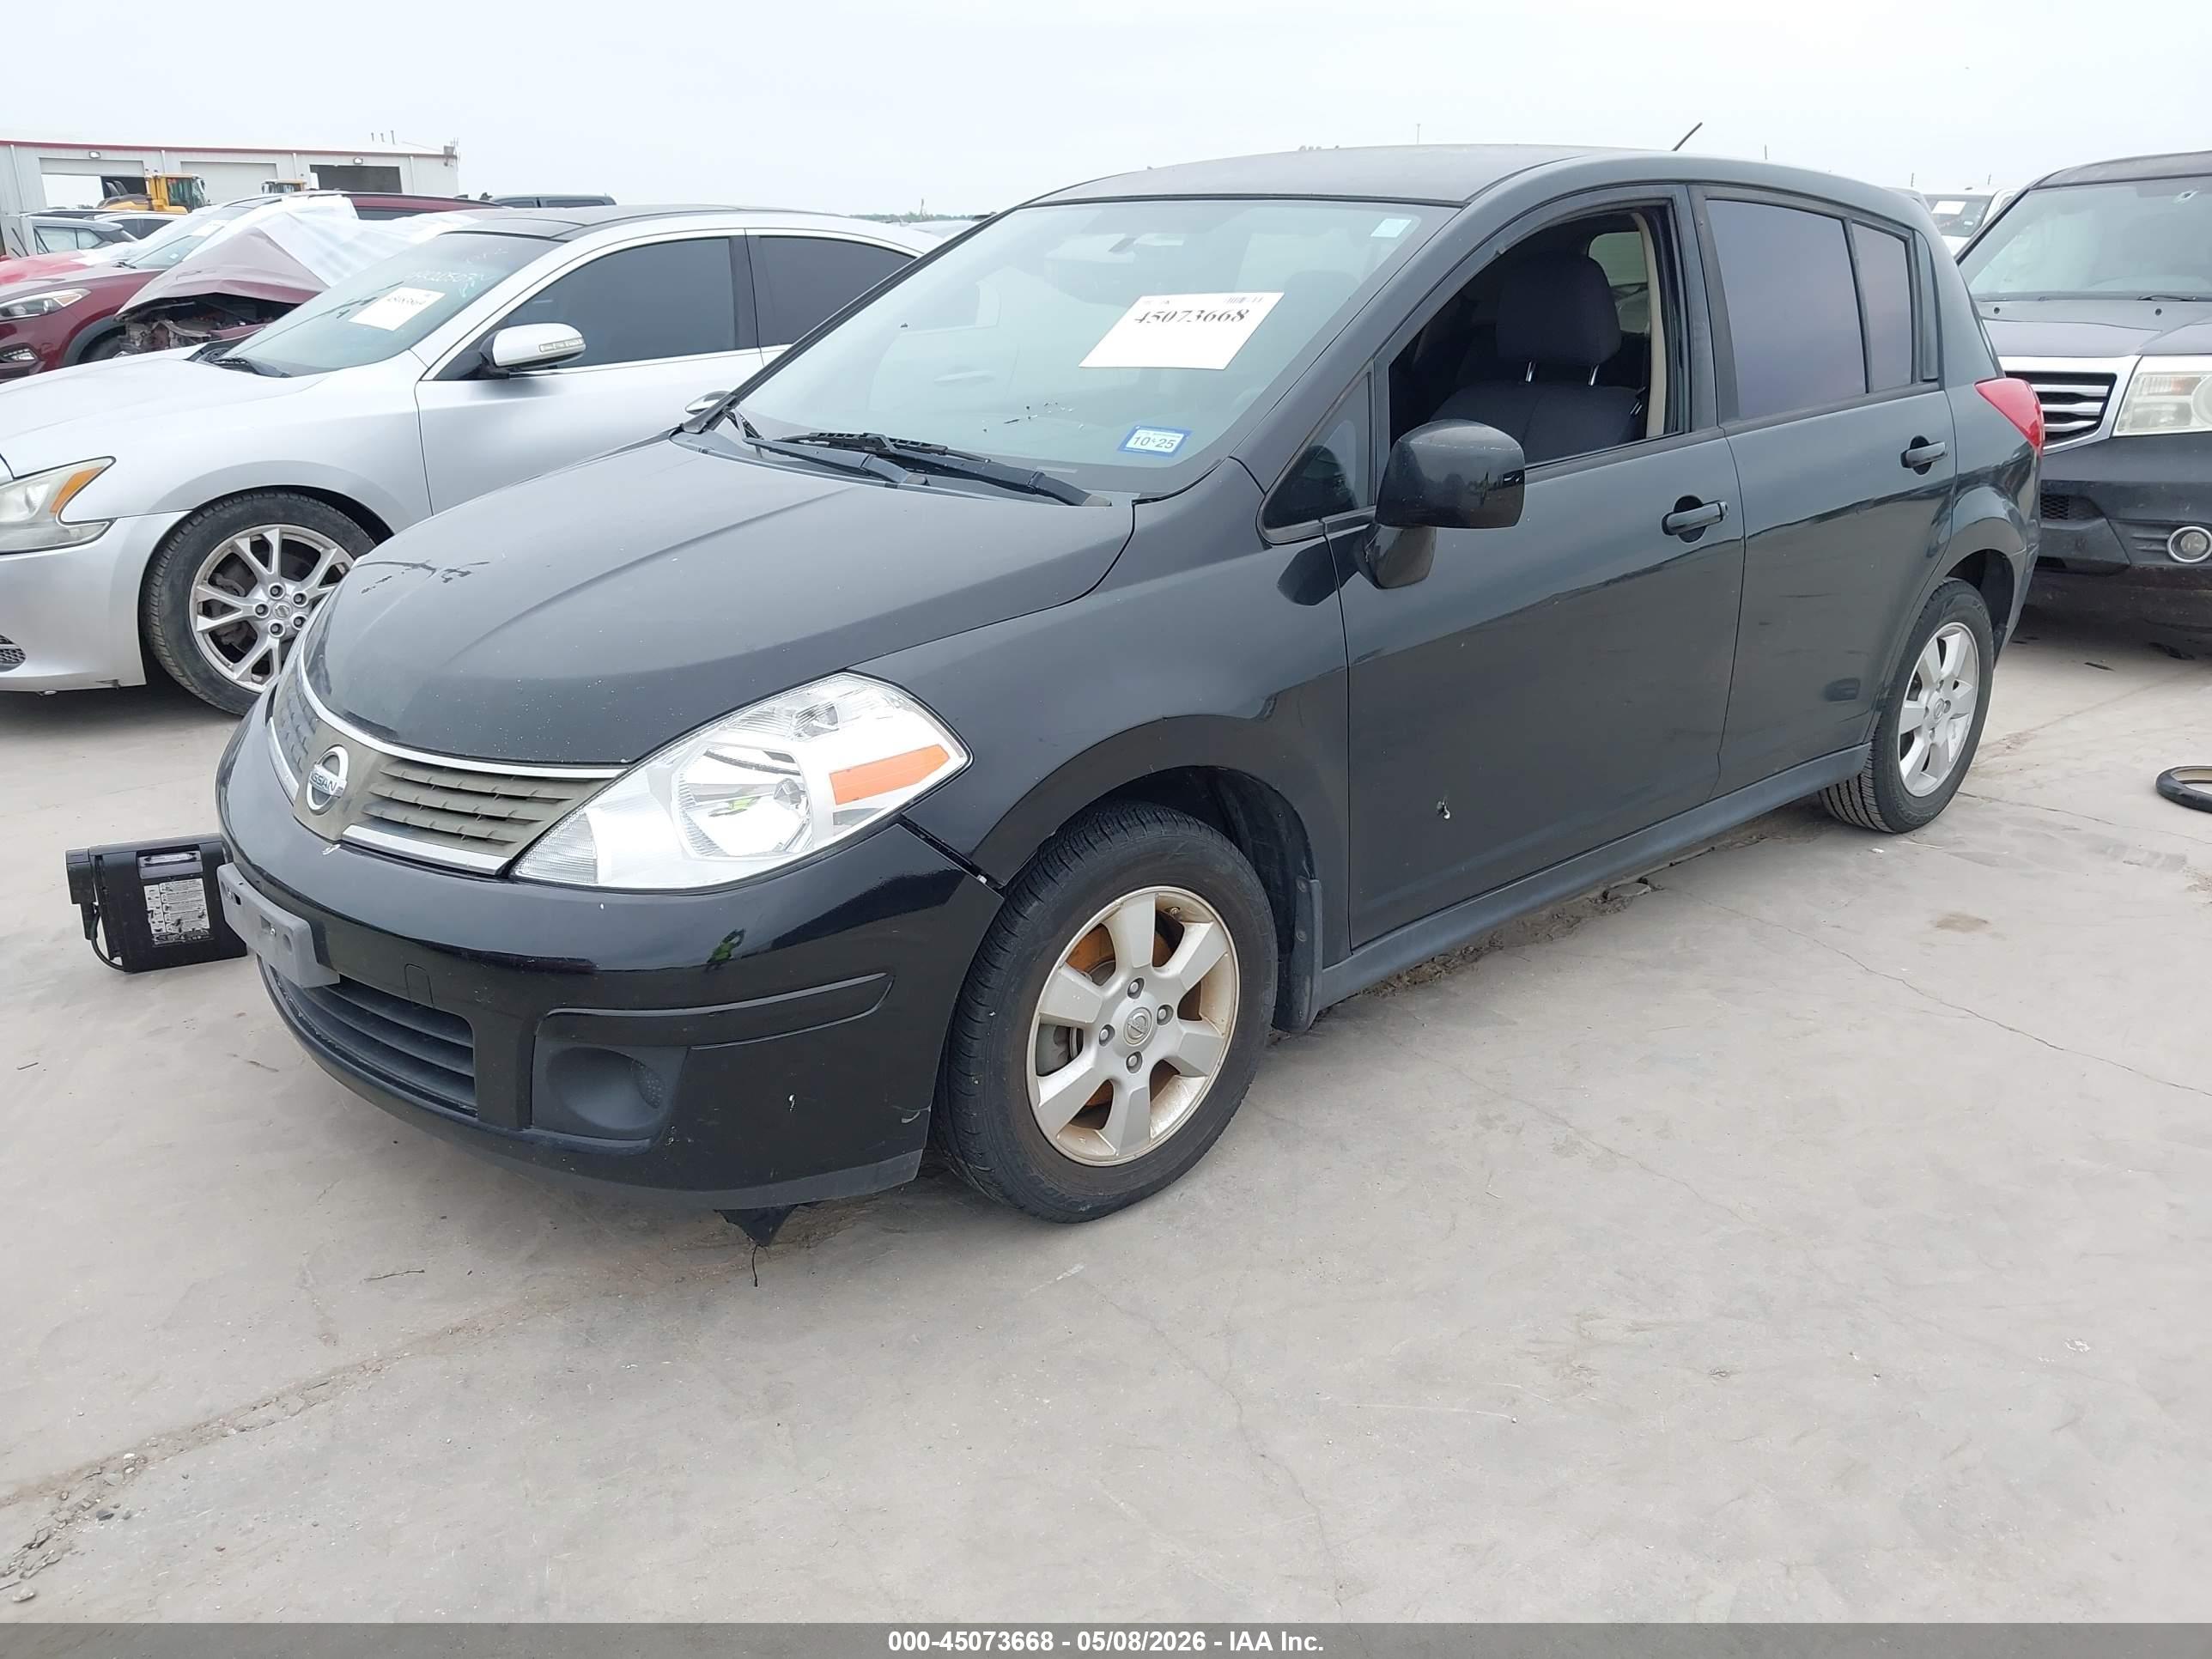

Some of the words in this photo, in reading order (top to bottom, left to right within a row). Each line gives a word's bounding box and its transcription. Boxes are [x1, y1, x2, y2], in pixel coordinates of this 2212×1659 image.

[1134, 309, 1249, 324] 45073668
[1133, 436, 1151, 447] 10
[1155, 438, 1176, 449] 25
[310, 772, 337, 792] ISSAN
